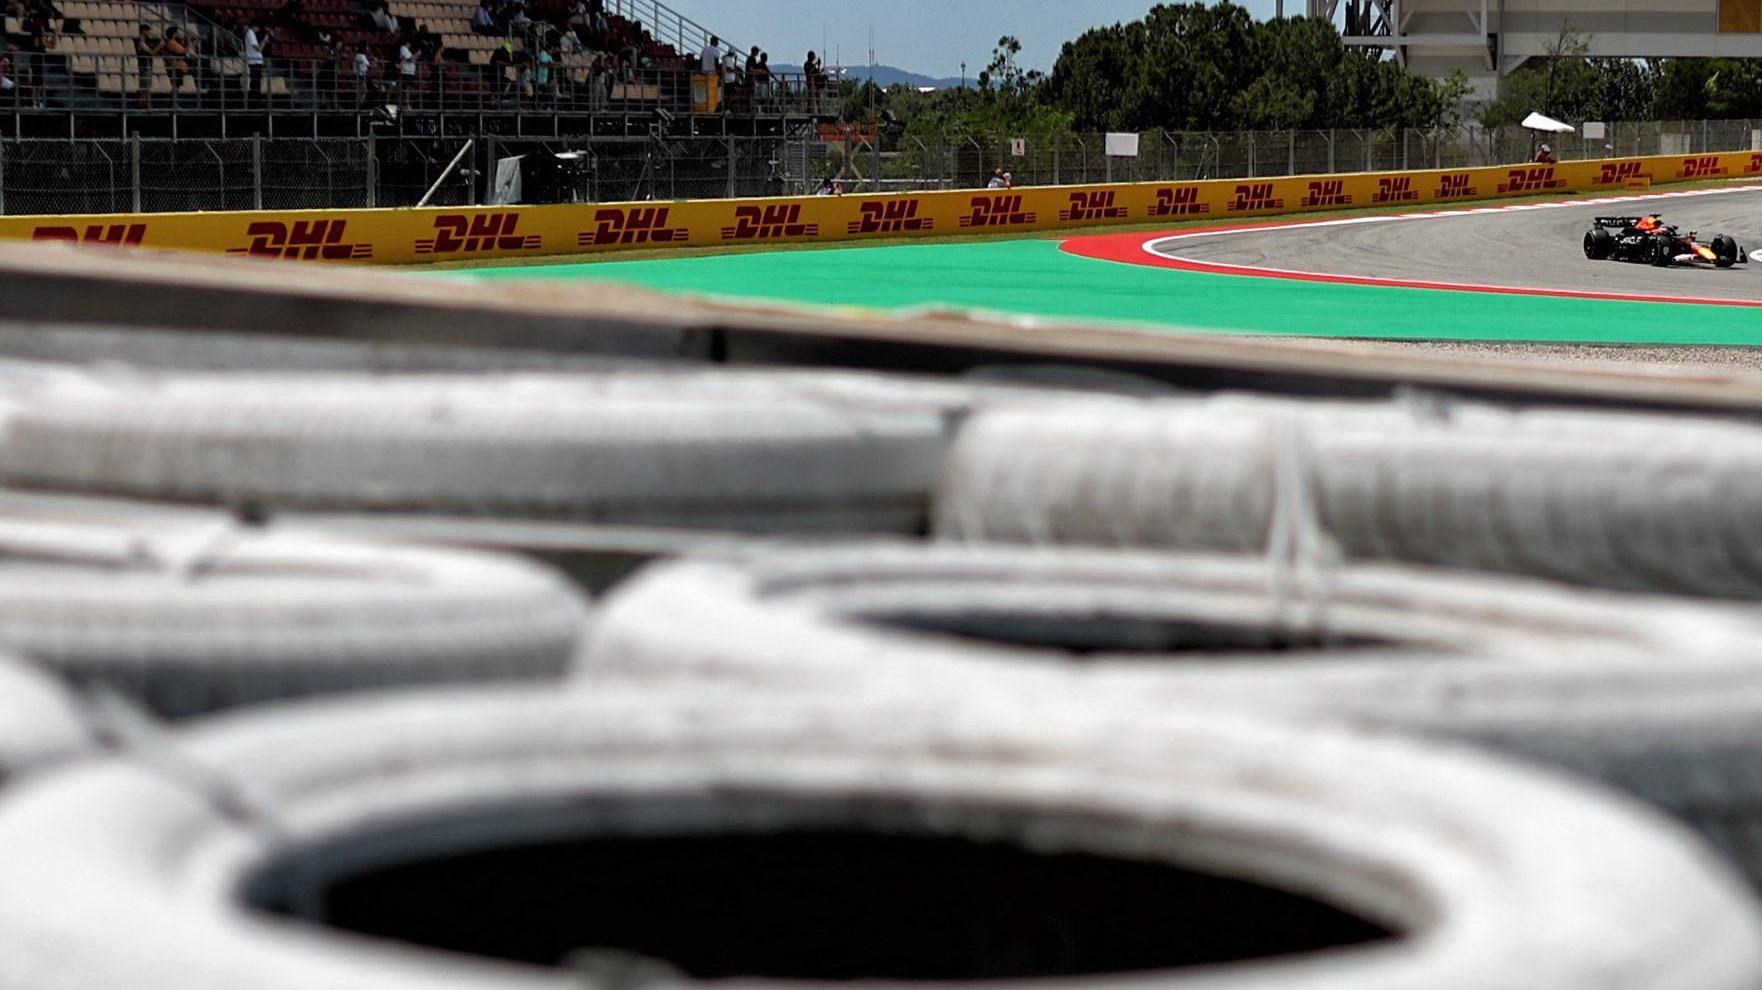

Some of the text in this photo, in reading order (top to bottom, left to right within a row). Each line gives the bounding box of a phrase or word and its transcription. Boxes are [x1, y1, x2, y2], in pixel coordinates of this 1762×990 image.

[1508, 168, 1557, 190] DHL
[1600, 162, 1644, 184] DHL
[1682, 157, 1721, 177] DHL
[1235, 184, 1276, 210] DHL
[1308, 180, 1345, 206] DHL
[1379, 177, 1412, 201] DHL
[1440, 174, 1471, 197] DHL
[970, 195, 1026, 227] DHL
[1069, 191, 1118, 220] DHL
[1156, 187, 1202, 215] DHL
[593, 208, 674, 245] DHL
[735, 204, 805, 239] DHL
[860, 199, 922, 233] DHL
[246, 220, 354, 259] DHL
[433, 213, 524, 252] DHL
